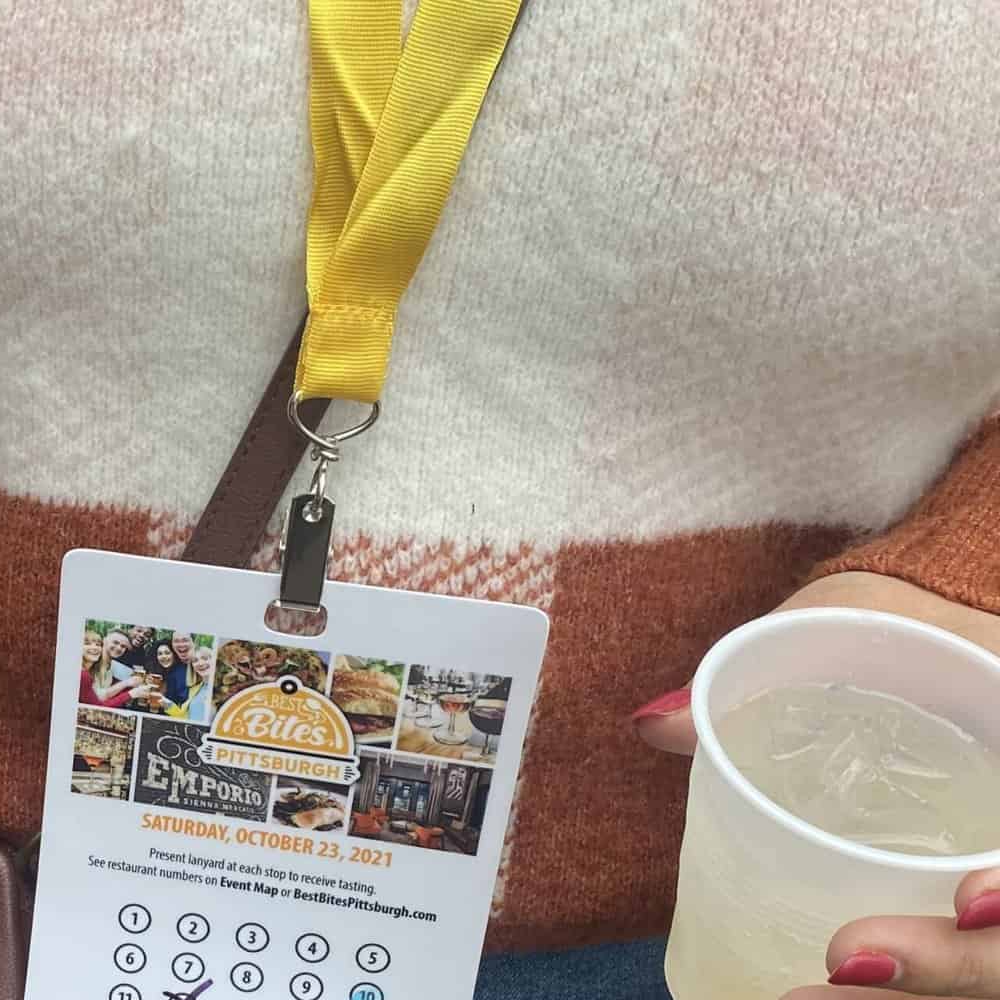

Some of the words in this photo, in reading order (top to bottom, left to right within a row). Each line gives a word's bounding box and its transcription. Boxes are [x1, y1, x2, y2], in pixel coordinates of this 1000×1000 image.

[243, 708, 327, 746] Bites
[271, 694, 303, 713] BEST
[142, 752, 262, 806] EMPORIO
[216, 748, 340, 778] PITTSBURGH
[141, 813, 232, 844] SATURDAY,
[236, 827, 314, 854] OCTOBER
[317, 841, 344, 862] 23,
[350, 847, 393, 868] 2021
[88, 855, 106, 868] See
[107, 859, 157, 876] restaurant
[159, 867, 203, 884] numbers
[205, 876, 218, 886] on
[220, 876, 251, 891] Event
[253, 882, 278, 898] Map
[281, 887, 291, 898] or
[294, 887, 437, 922] BestBitesPittsburgh.com
[149, 847, 186, 863] Present
[188, 853, 225, 871] lanyard
[227, 861, 237, 872] at
[239, 863, 262, 876] each
[264, 868, 286, 881] stop
[289, 871, 299, 882] to
[301, 874, 336, 888] receive
[338, 879, 377, 896] tasting.
